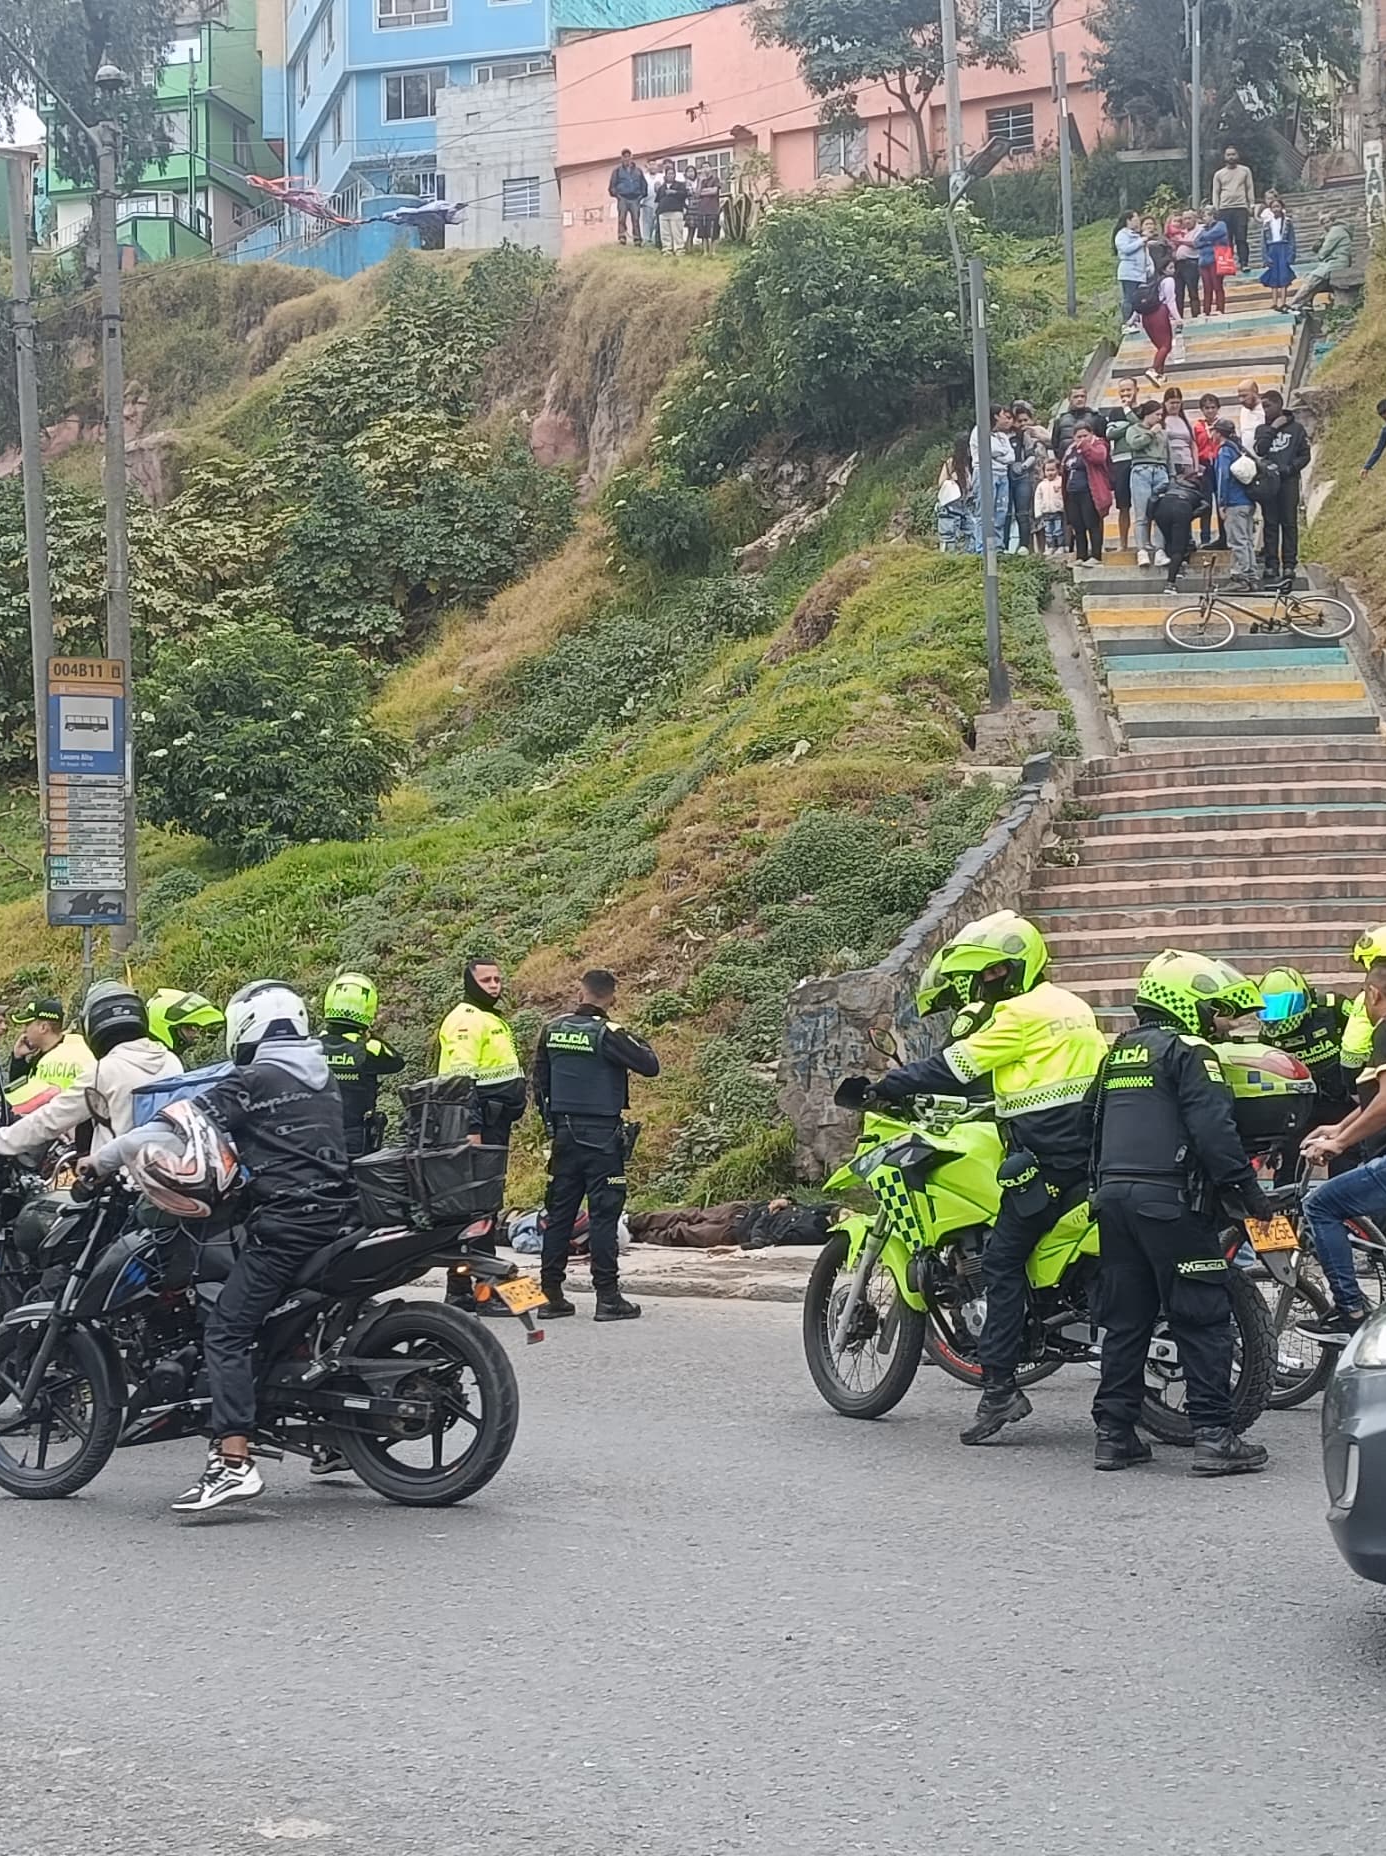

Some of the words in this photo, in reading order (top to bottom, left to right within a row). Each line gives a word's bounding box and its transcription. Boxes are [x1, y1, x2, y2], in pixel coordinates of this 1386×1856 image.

[53, 662, 102, 678] 004B11
[549, 1032, 590, 1045] POLICÍA
[1295, 1040, 1334, 1060] OLICÍA
[325, 1053, 355, 1065] LICÍA
